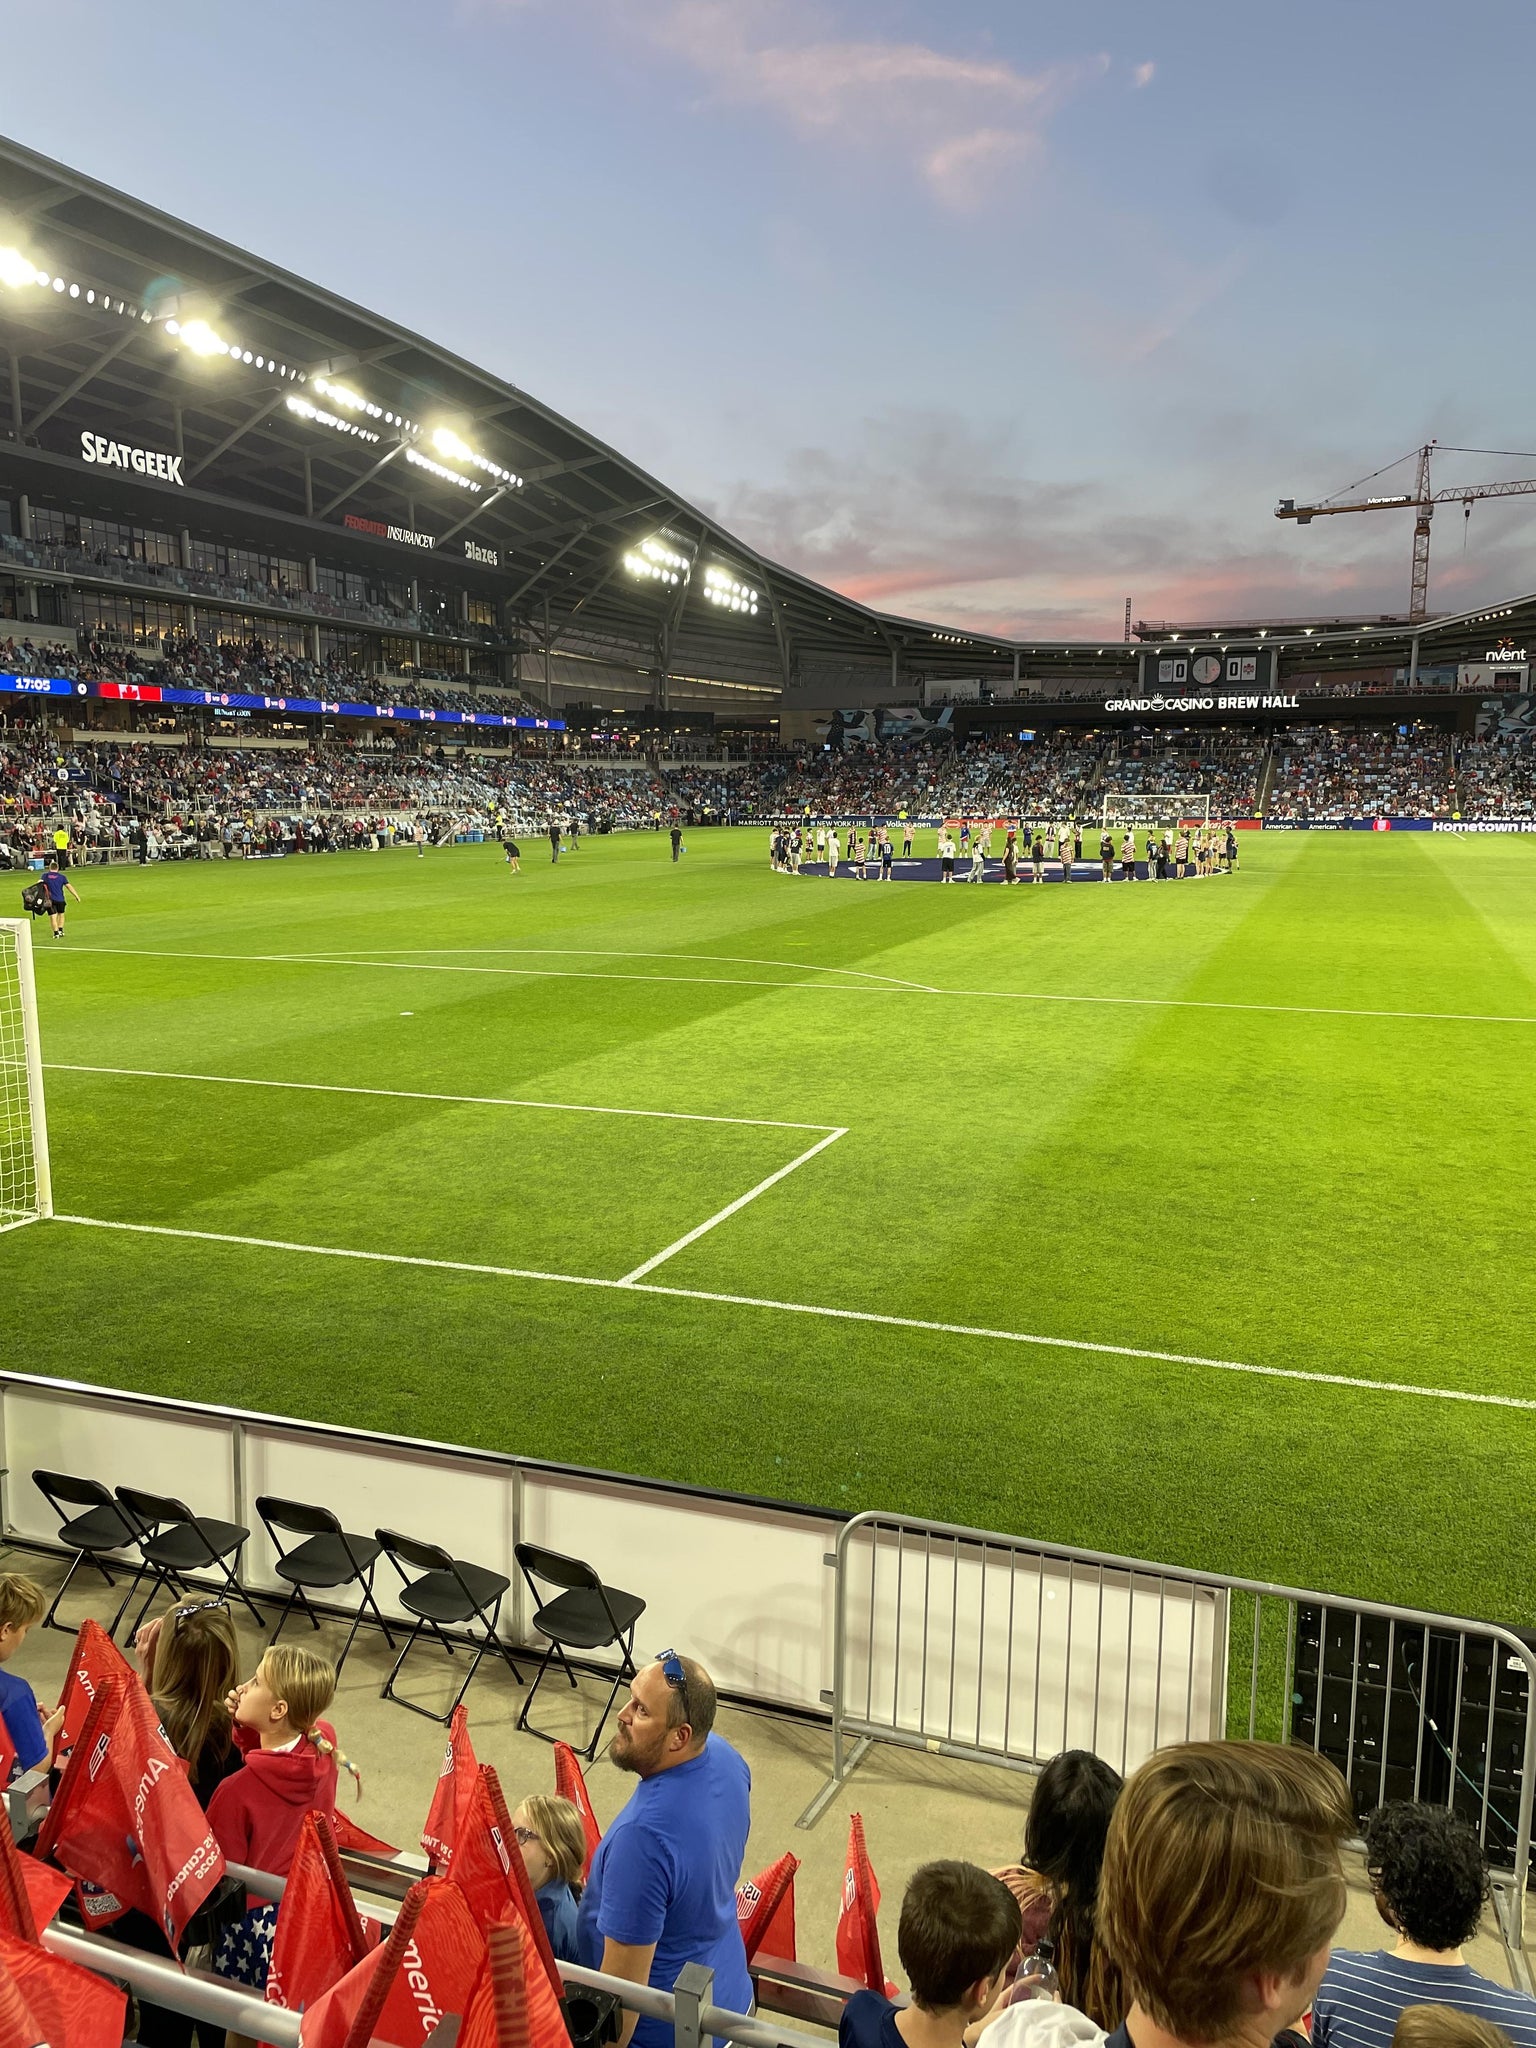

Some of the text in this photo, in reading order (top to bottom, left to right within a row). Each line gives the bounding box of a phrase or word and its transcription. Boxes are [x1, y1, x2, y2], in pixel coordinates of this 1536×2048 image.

[81, 431, 184, 486] SEATGEEK
[387, 525, 429, 548] INSURANCE
[1176, 663, 1185, 678] 0
[1230, 661, 1239, 677] 0
[15, 677, 51, 691] 17:05
[1105, 696, 1300, 712] GRAND CASINO BREW HALL
[886, 820, 931, 829] Volksagen
[967, 820, 996, 828] Henel
[1432, 821, 1518, 832] Hometown
[402, 1938, 443, 2039] meric
